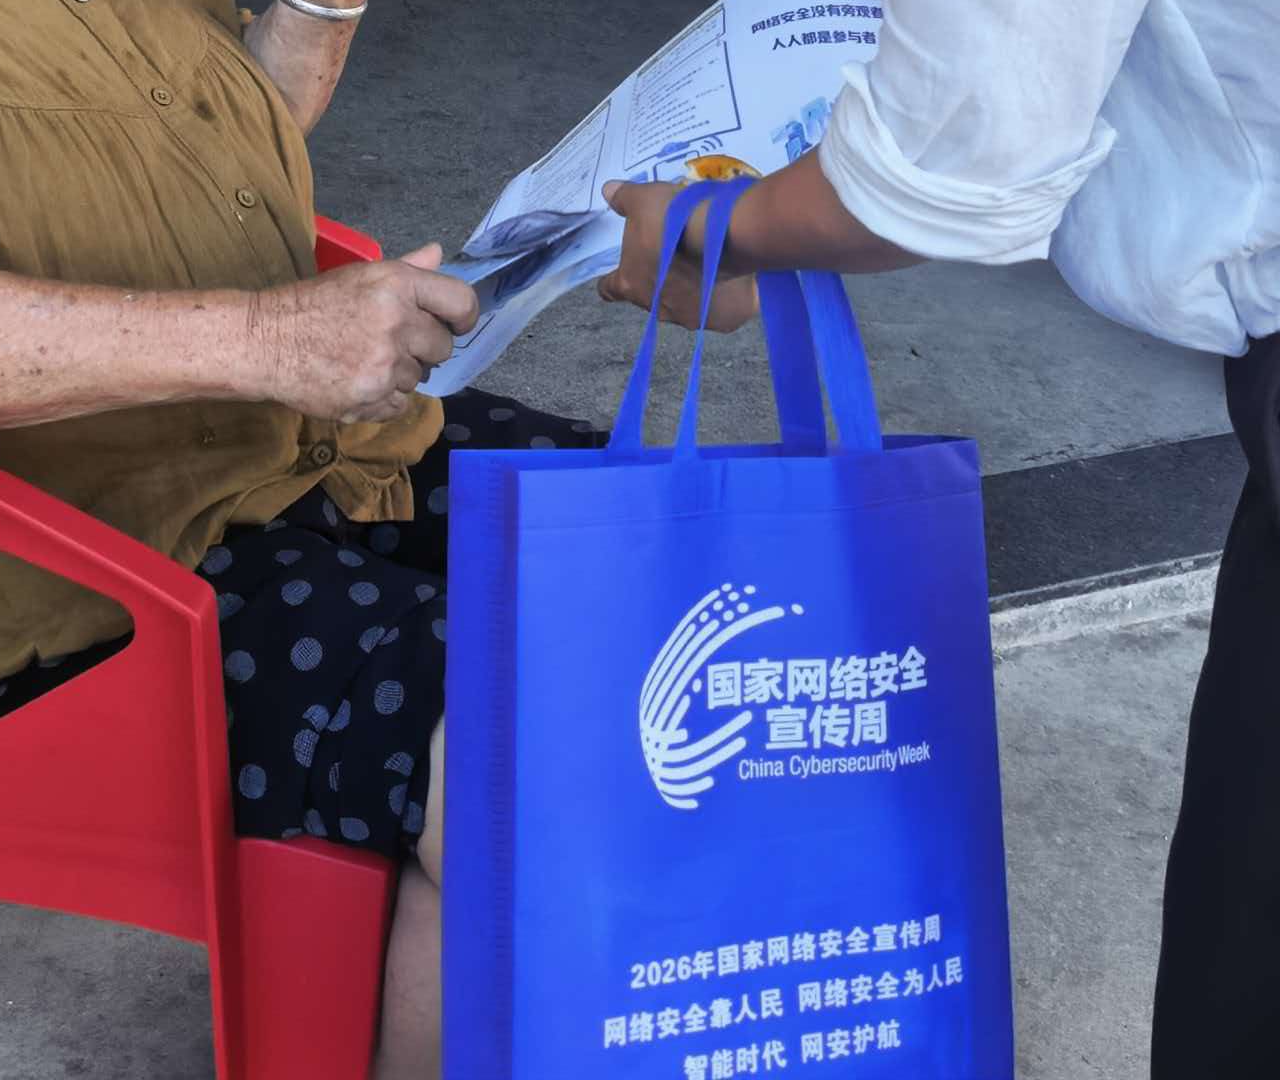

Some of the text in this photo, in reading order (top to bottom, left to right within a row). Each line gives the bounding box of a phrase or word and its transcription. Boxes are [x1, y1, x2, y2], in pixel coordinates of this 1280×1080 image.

[751, 3, 883, 34] 网络安全没有旁观者
[772, 30, 876, 50] 人人都是参与者
[707, 646, 927, 710] 国家网络安全
[765, 700, 888, 750] 宣传周
[738, 741, 931, 780] China Cybersecurity Week
[630, 914, 941, 990] 2026年国家网络安全宣传周
[603, 956, 963, 1049] 网络安全靠人民 网络安全为人民
[683, 1019, 902, 1080] 智能时代 网安护航
